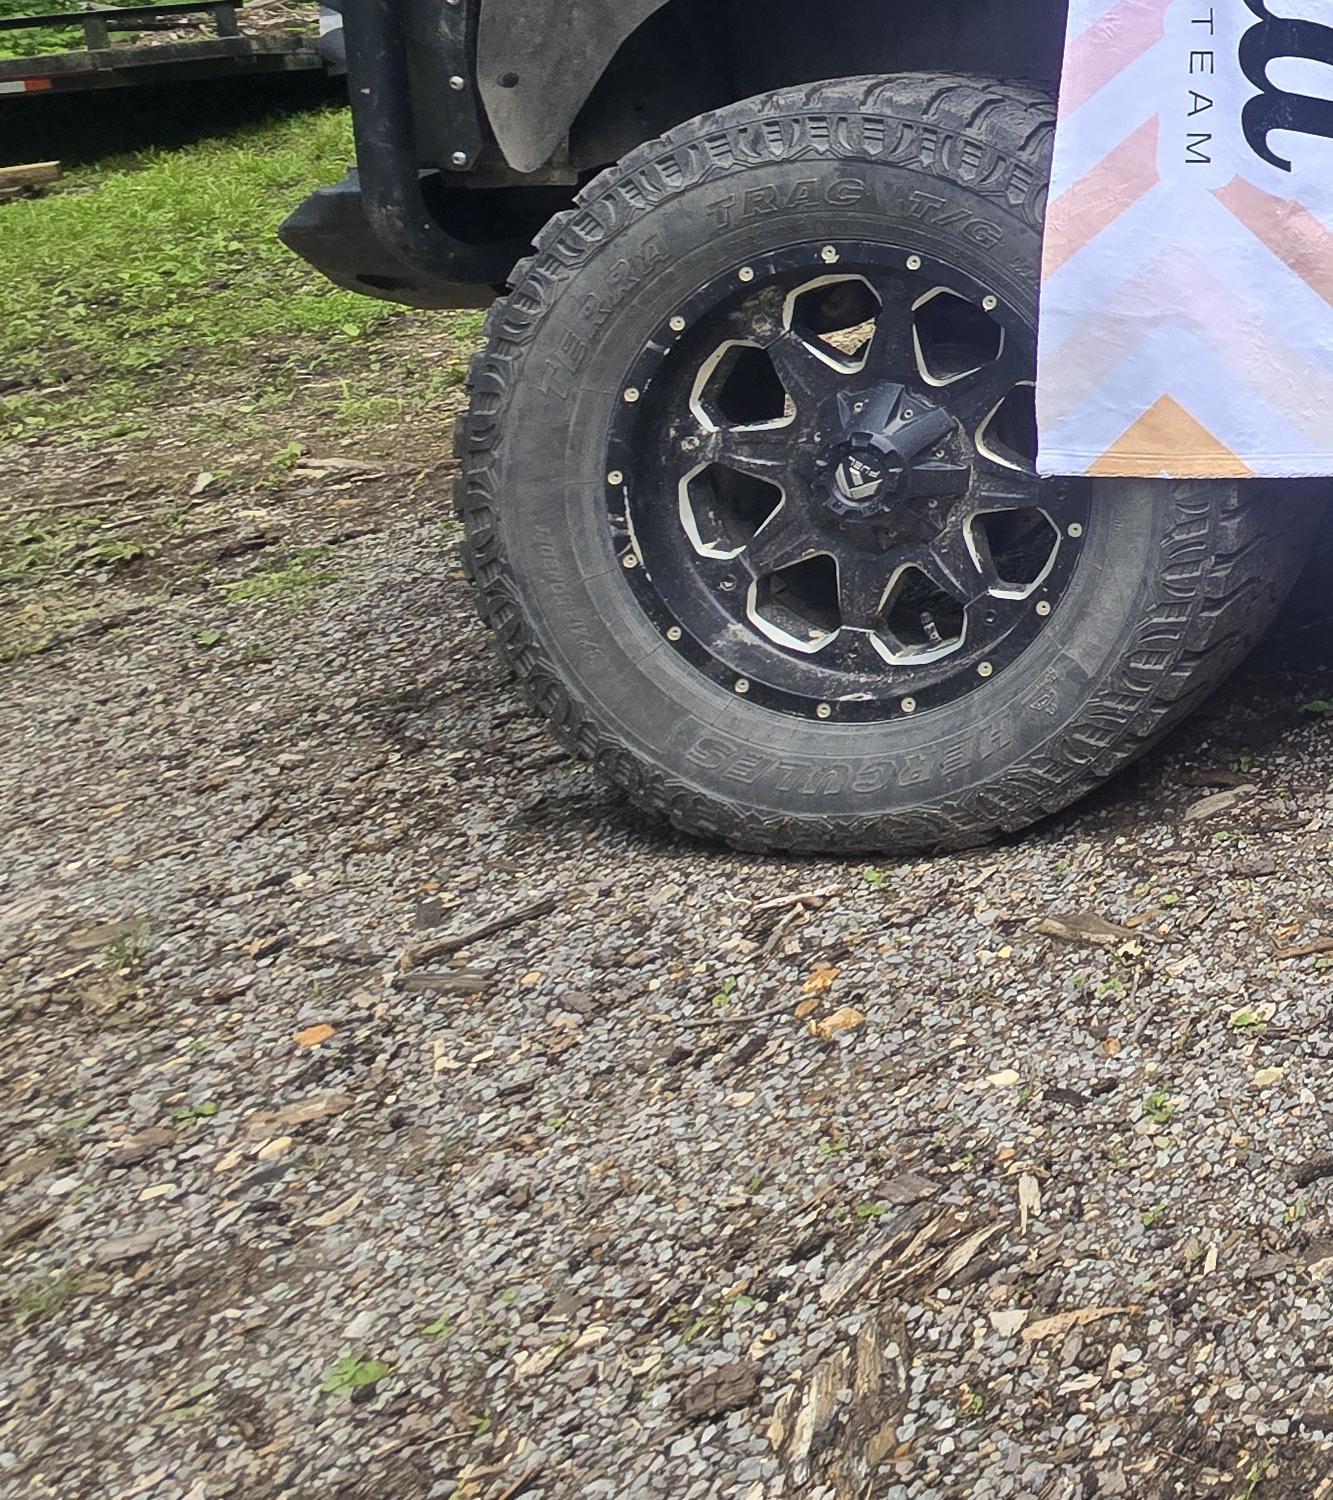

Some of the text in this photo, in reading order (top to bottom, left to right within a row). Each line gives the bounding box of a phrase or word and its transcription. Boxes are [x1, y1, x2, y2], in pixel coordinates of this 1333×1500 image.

[1184, 7, 1215, 165] TEAM
[540, 230, 673, 403] TERRA
[705, 177, 870, 231] TRAC
[905, 189, 1004, 250] T/G
[847, 455, 881, 478] FUEL
[685, 712, 1016, 796] HERCULES
